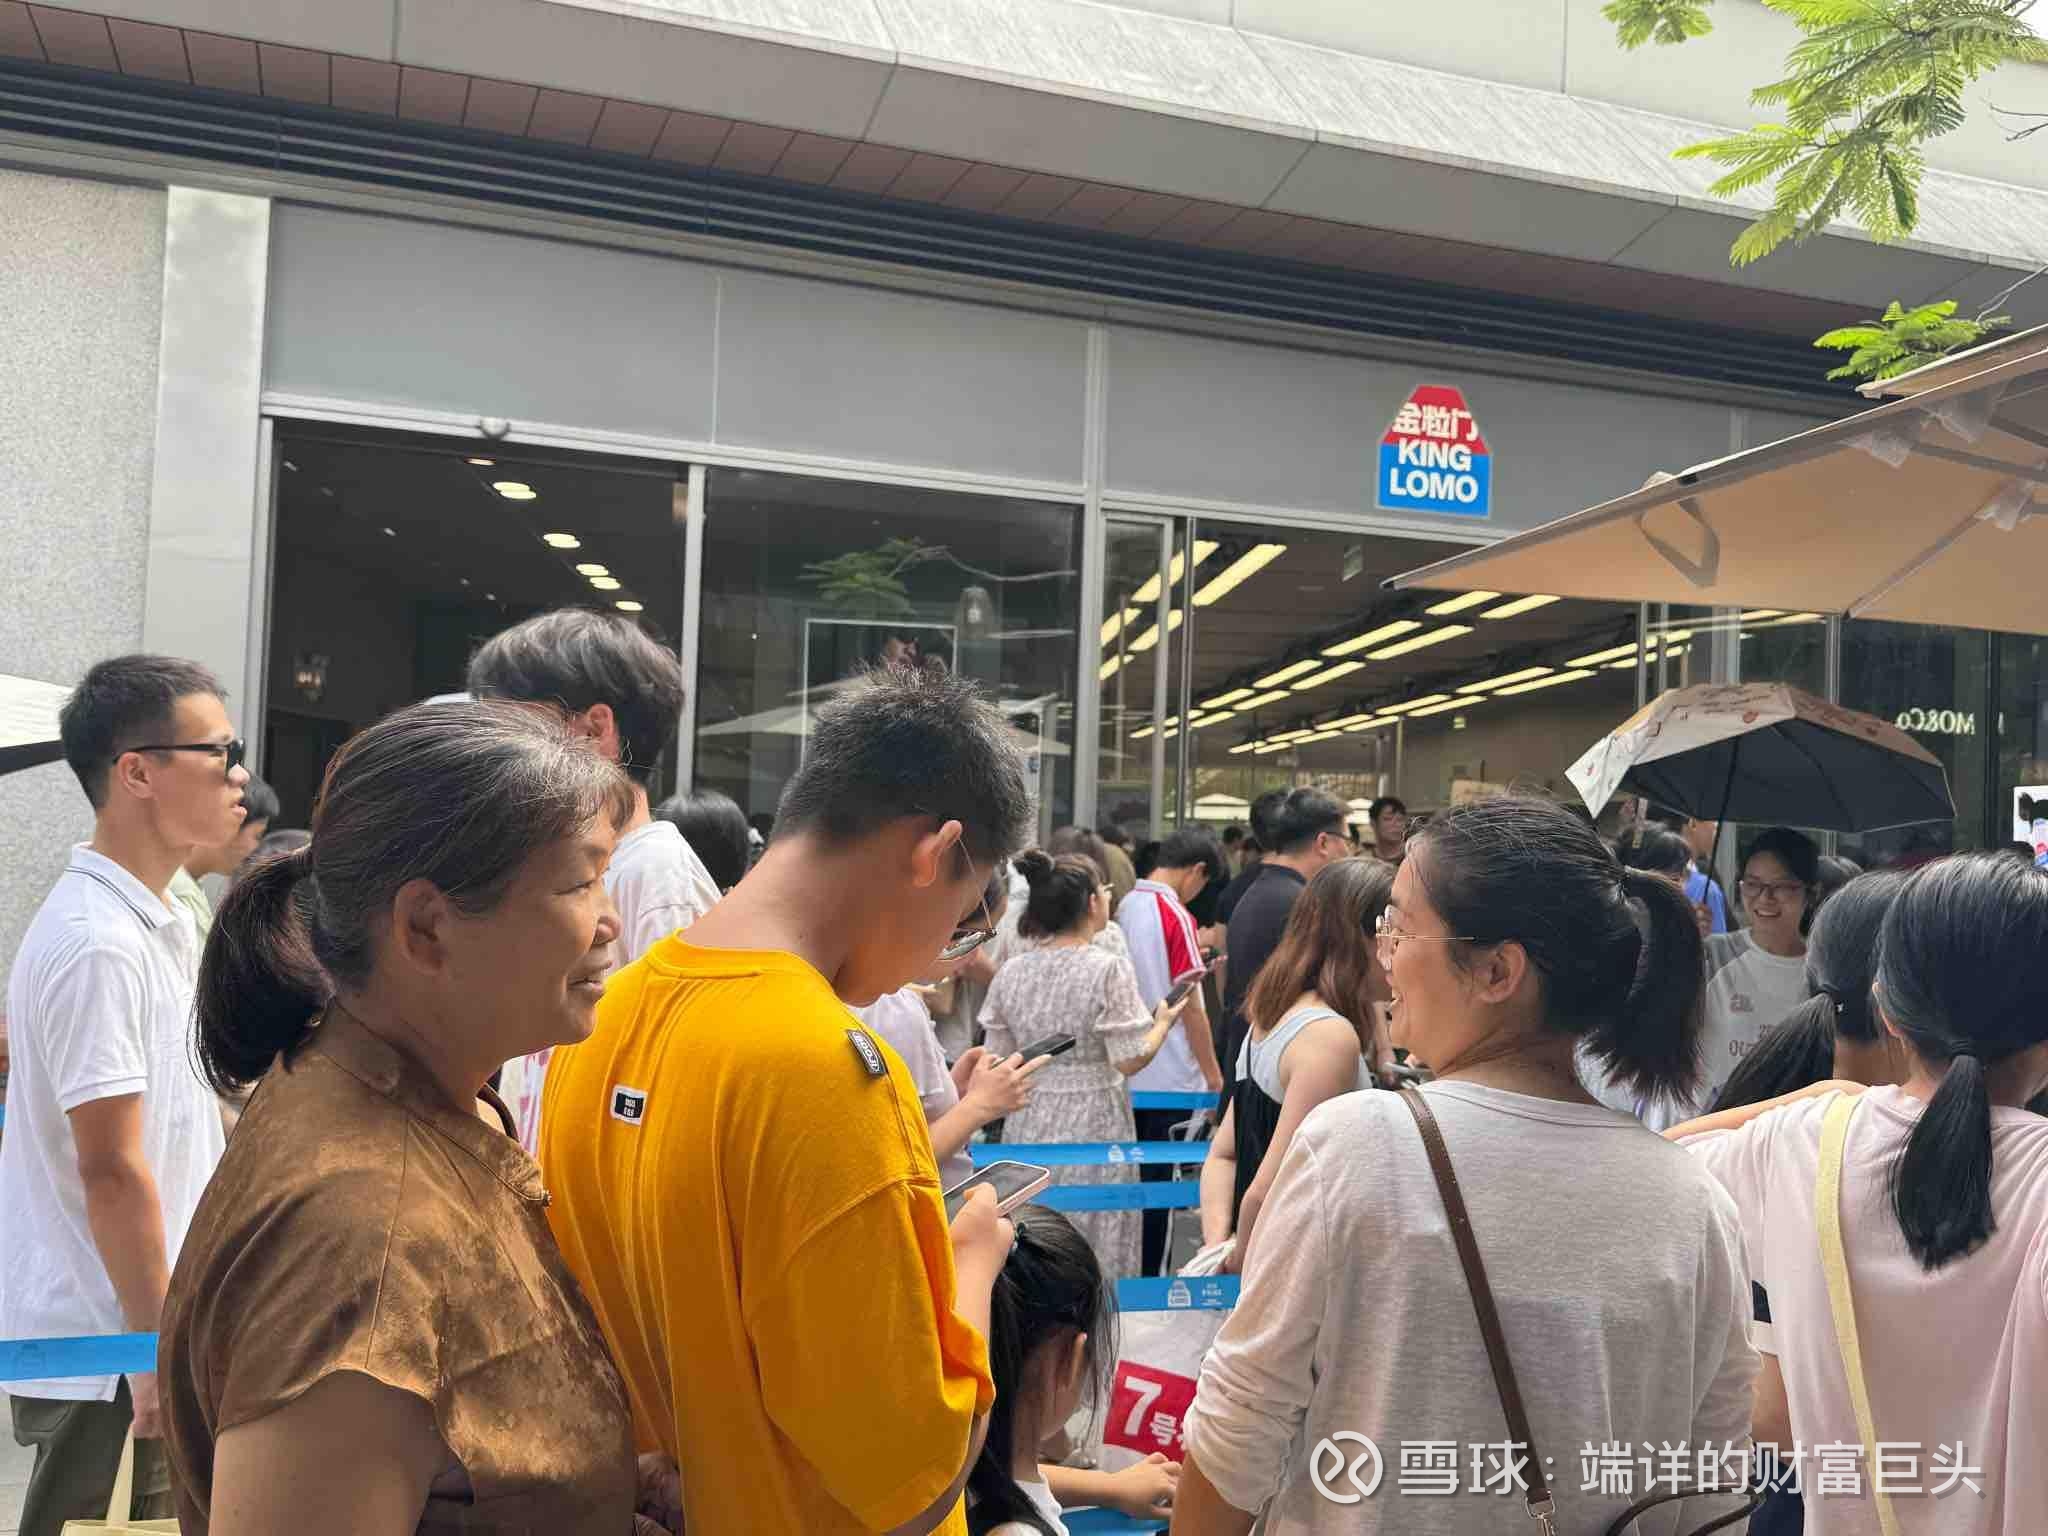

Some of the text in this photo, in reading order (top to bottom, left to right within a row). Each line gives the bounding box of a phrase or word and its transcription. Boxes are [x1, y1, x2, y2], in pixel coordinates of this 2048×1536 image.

[1391, 402, 1479, 441] 金粒门
[1398, 438, 1472, 471] KING
[1389, 467, 1479, 503] LOMO
[1123, 1375, 1184, 1451] 7号
